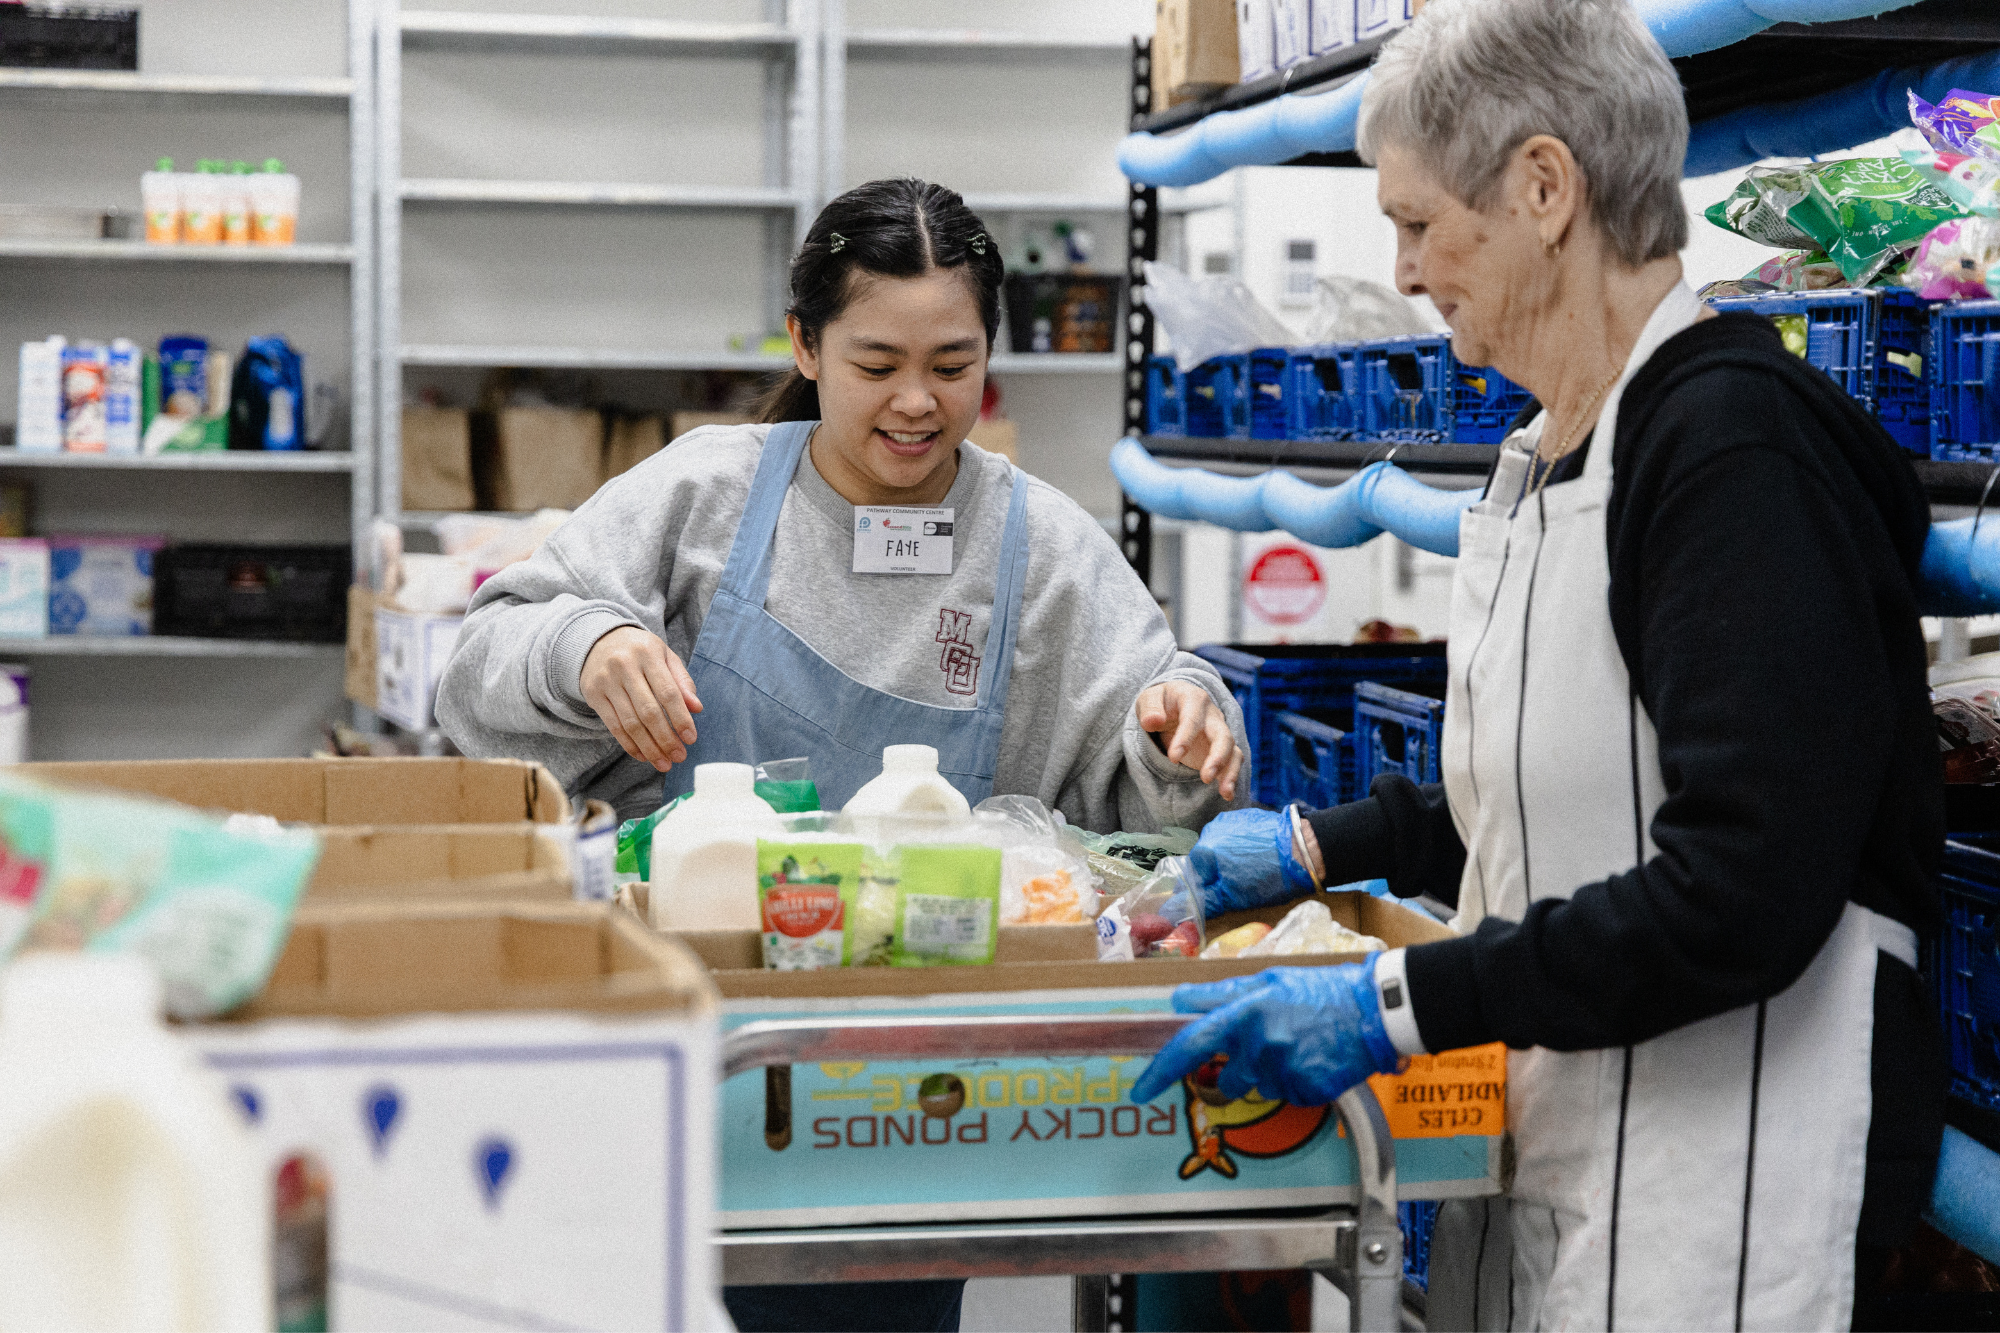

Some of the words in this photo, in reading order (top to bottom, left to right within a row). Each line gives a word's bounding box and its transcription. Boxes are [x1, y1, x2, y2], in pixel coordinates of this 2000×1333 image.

[1873, 184, 1905, 192] WILD
[885, 539, 920, 557] FAYE
[812, 1112, 989, 1149] PONDS
[1010, 1104, 1178, 1142] ROCKY
